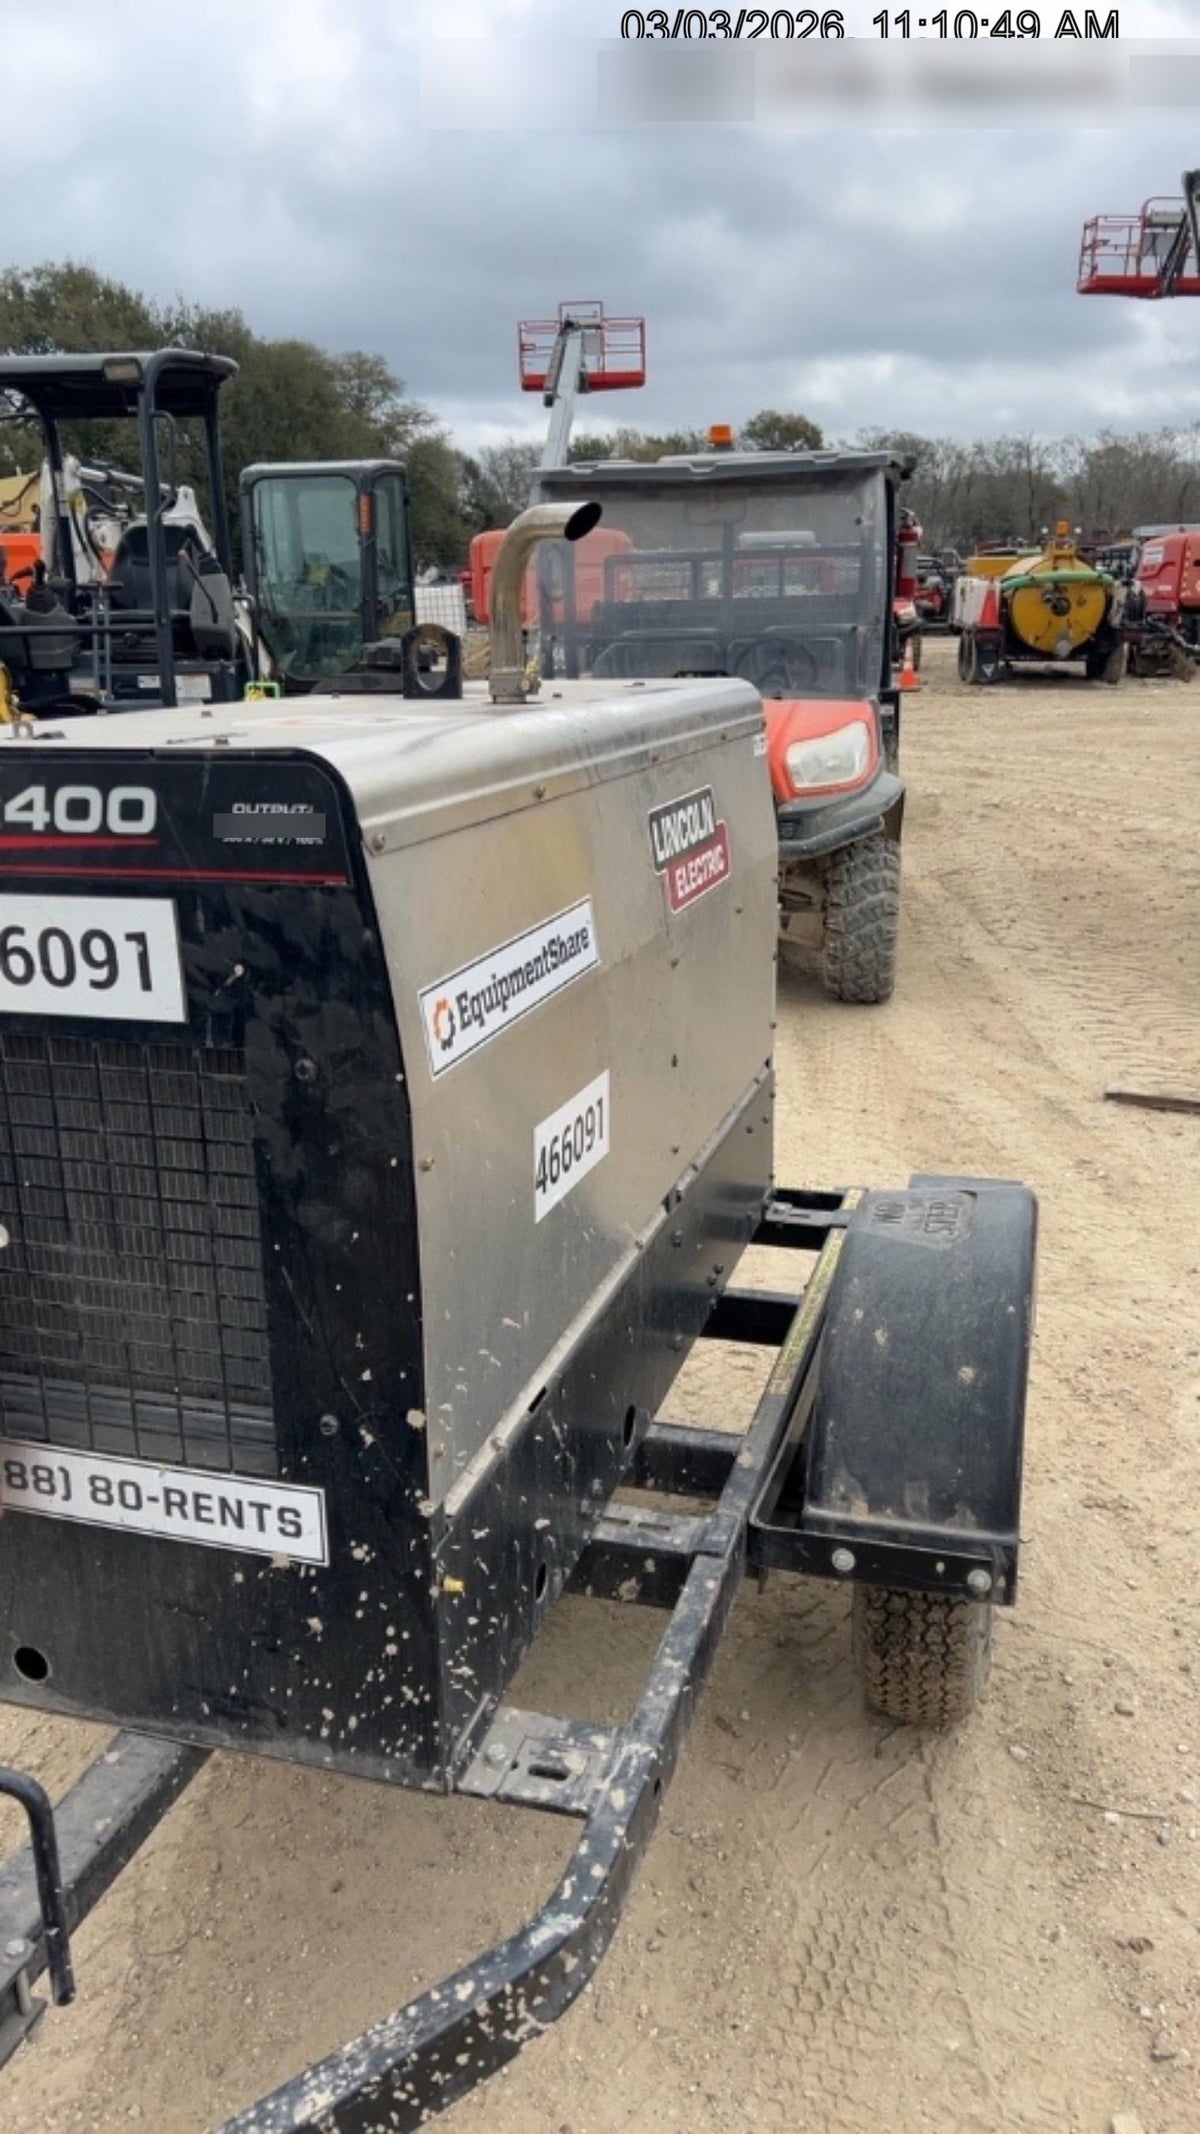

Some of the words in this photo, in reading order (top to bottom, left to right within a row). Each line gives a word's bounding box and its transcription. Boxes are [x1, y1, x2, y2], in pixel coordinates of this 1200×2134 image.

[4, 784, 157, 834] 400
[652, 795, 714, 862] LINCOLN
[675, 844, 724, 899] ELECTRIC
[0, 924, 152, 992] 6091
[456, 926, 590, 1031] EquipmentShare
[536, 1097, 604, 1194] 466091
[4, 1460, 72, 1502] 88)
[88, 1474, 303, 1539] 80-RENTS
